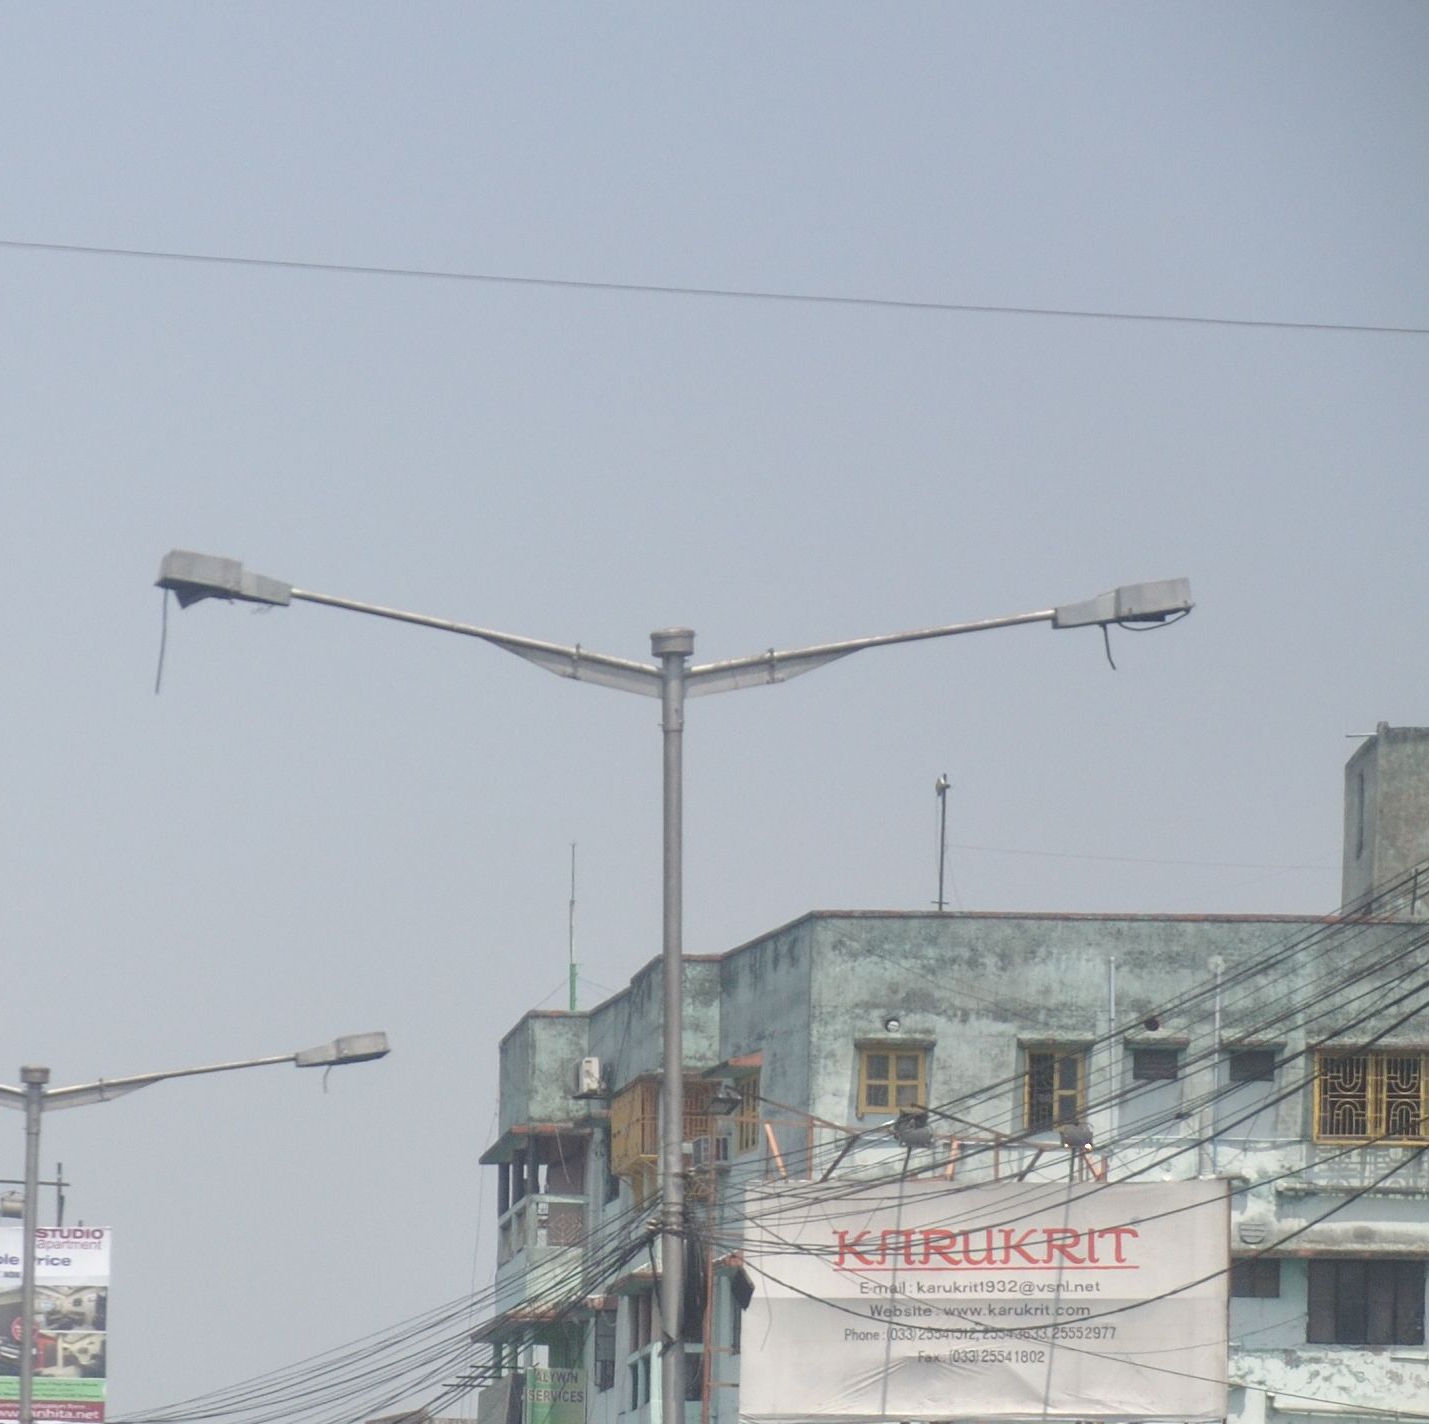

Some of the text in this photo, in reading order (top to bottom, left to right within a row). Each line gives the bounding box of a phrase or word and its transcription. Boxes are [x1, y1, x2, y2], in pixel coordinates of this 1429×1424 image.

[833, 1227, 1139, 1266] KARUKRIT
[916, 1280, 1101, 1296] karukrit1932@vsnl.net
[869, 1304, 1091, 1318] Website www.karukrit.com
[1052, 1327, 1117, 1340] 25552977
[528, 1389, 585, 1403] SERVICES
